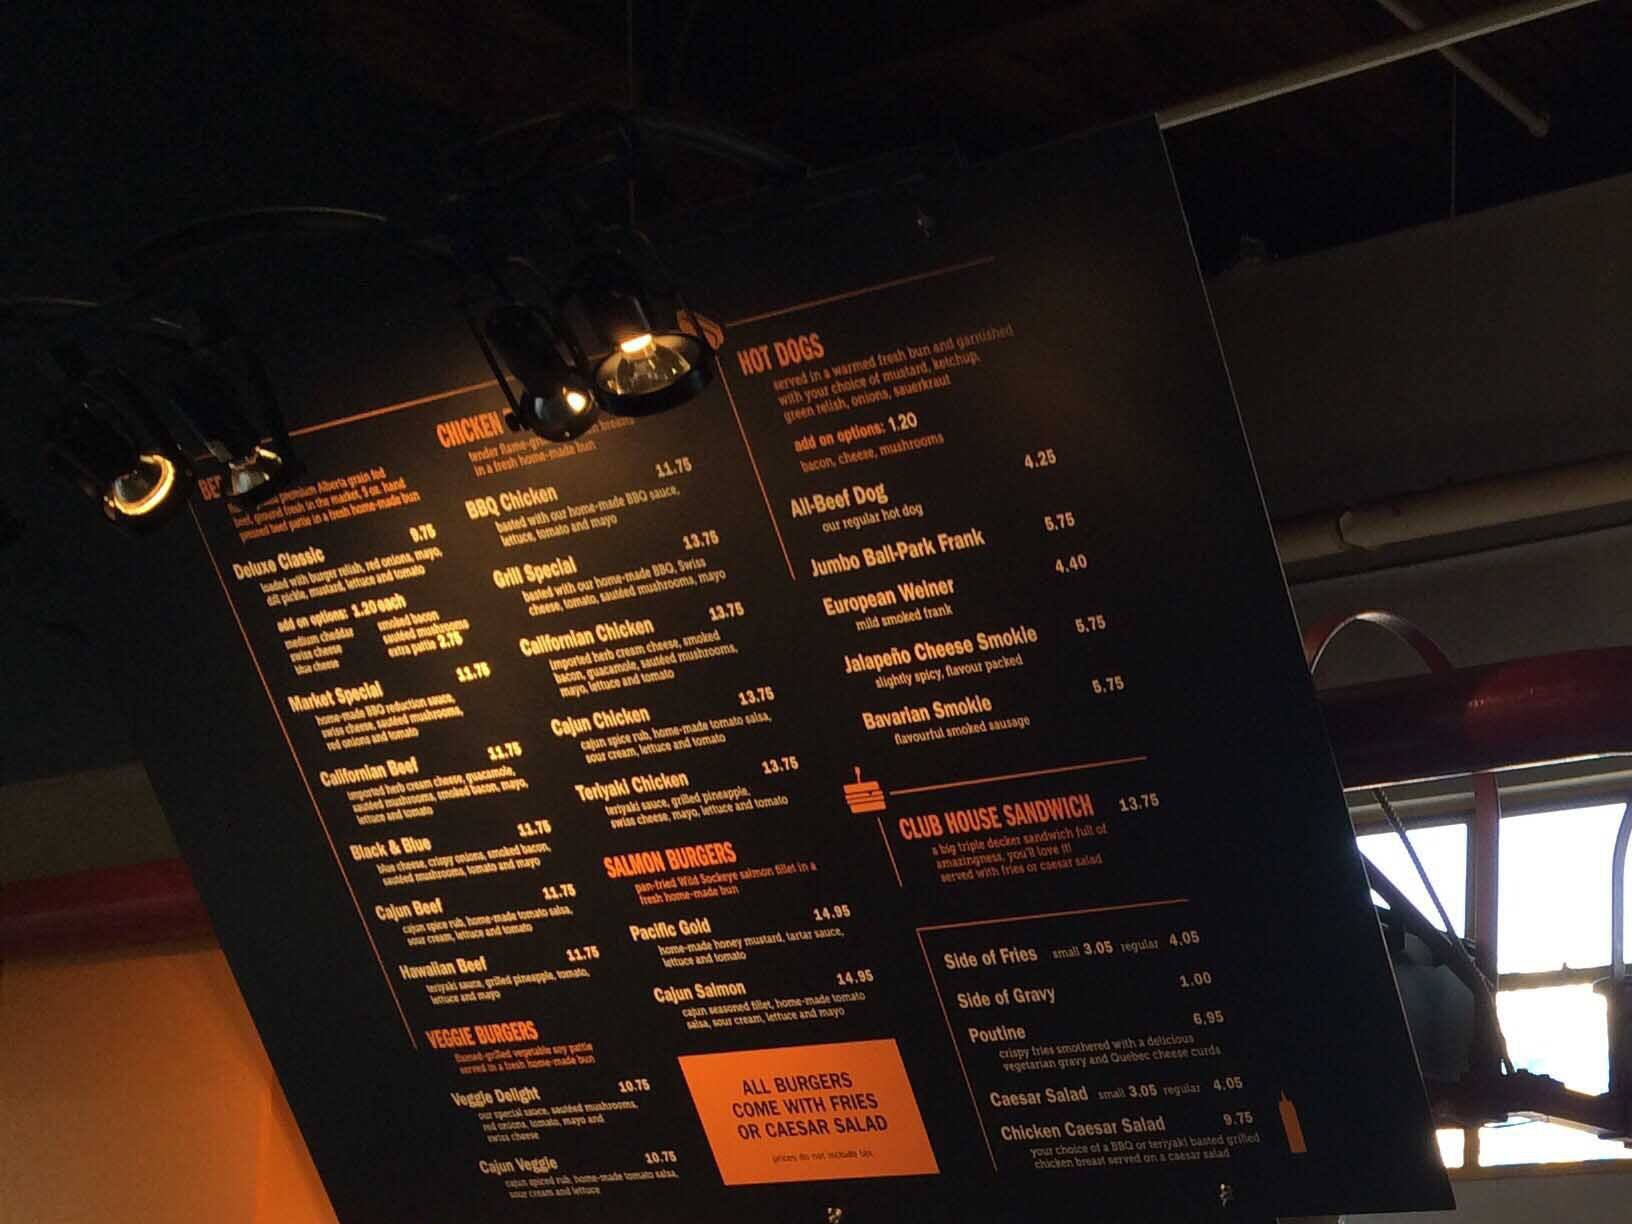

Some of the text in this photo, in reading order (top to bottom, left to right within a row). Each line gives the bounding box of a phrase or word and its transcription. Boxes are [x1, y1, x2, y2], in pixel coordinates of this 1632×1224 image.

[737, 333, 824, 374] HOT DOGS
[437, 412, 502, 446] CHICKEN
[794, 434, 816, 452] add
[818, 433, 834, 446] on
[887, 411, 917, 431] 1.20
[464, 456, 692, 519] BBQ Chicken 11.75
[790, 448, 1056, 517] All-Beef Dog 4.25
[232, 523, 436, 579] Deluxe Classic 9.75
[492, 529, 719, 588] Grill Special 13.75
[811, 553, 860, 576] Jumbo
[862, 537, 935, 566] Ball-Park
[937, 528, 984, 552] Frank
[822, 553, 1087, 615] European Weiner 4.40
[276, 616, 296, 632] add
[295, 616, 310, 628] on
[350, 599, 377, 618] 1.20
[376, 592, 406, 612] each
[519, 601, 744, 656] Californian Chicken 13.75
[844, 647, 911, 672] Jalapeño
[913, 639, 973, 660] Cheese
[976, 626, 1037, 650] Smokie
[287, 661, 490, 711] Market Special 11.75
[550, 686, 774, 736] Cajun Chicken 13.75
[862, 706, 930, 729] Bavarian
[932, 695, 991, 718] Smokie
[319, 741, 522, 786] Californian Beef 11.75
[574, 755, 798, 801] Teriyaki Chicken 13.75
[898, 792, 1159, 839] CLUB HOUSE SANDWICH 13.75
[349, 819, 551, 860] Black & Blue 11.75
[604, 842, 736, 877] SALMON BURGERS
[374, 883, 576, 921] Cajun Beef 11.75
[629, 904, 850, 940] Pacific Gold 14.95
[399, 945, 599, 978] Hawaiian Beef 11.75
[943, 952, 977, 969] Side
[981, 948, 996, 965] of
[999, 947, 1037, 963] Fries
[1082, 940, 1113, 955] 3.05
[1168, 930, 1200, 946] 4.05
[653, 968, 873, 1004] Cajun Salmon 14.95
[956, 971, 1211, 1008] Side of Gravy 1.00
[426, 1020, 537, 1047] VEGGIE BURGERS
[968, 1025, 1025, 1042] Poutine
[450, 1078, 650, 1108] Veggie Delight 10.75
[742, 1071, 852, 1094] ALL BURGERS
[989, 1091, 1040, 1107] Caesar
[1044, 1086, 1088, 1103] Salad
[1127, 1083, 1157, 1098] 3.05
[1213, 1075, 1243, 1090] 4.05
[732, 1092, 878, 1118] COME WITH FRIES
[737, 1114, 888, 1139] OR CAESAR SALAD
[1000, 1110, 1253, 1140] Chicken Caesar Salad 9.75
[478, 1150, 677, 1175] Cajun Veggie 10.75
